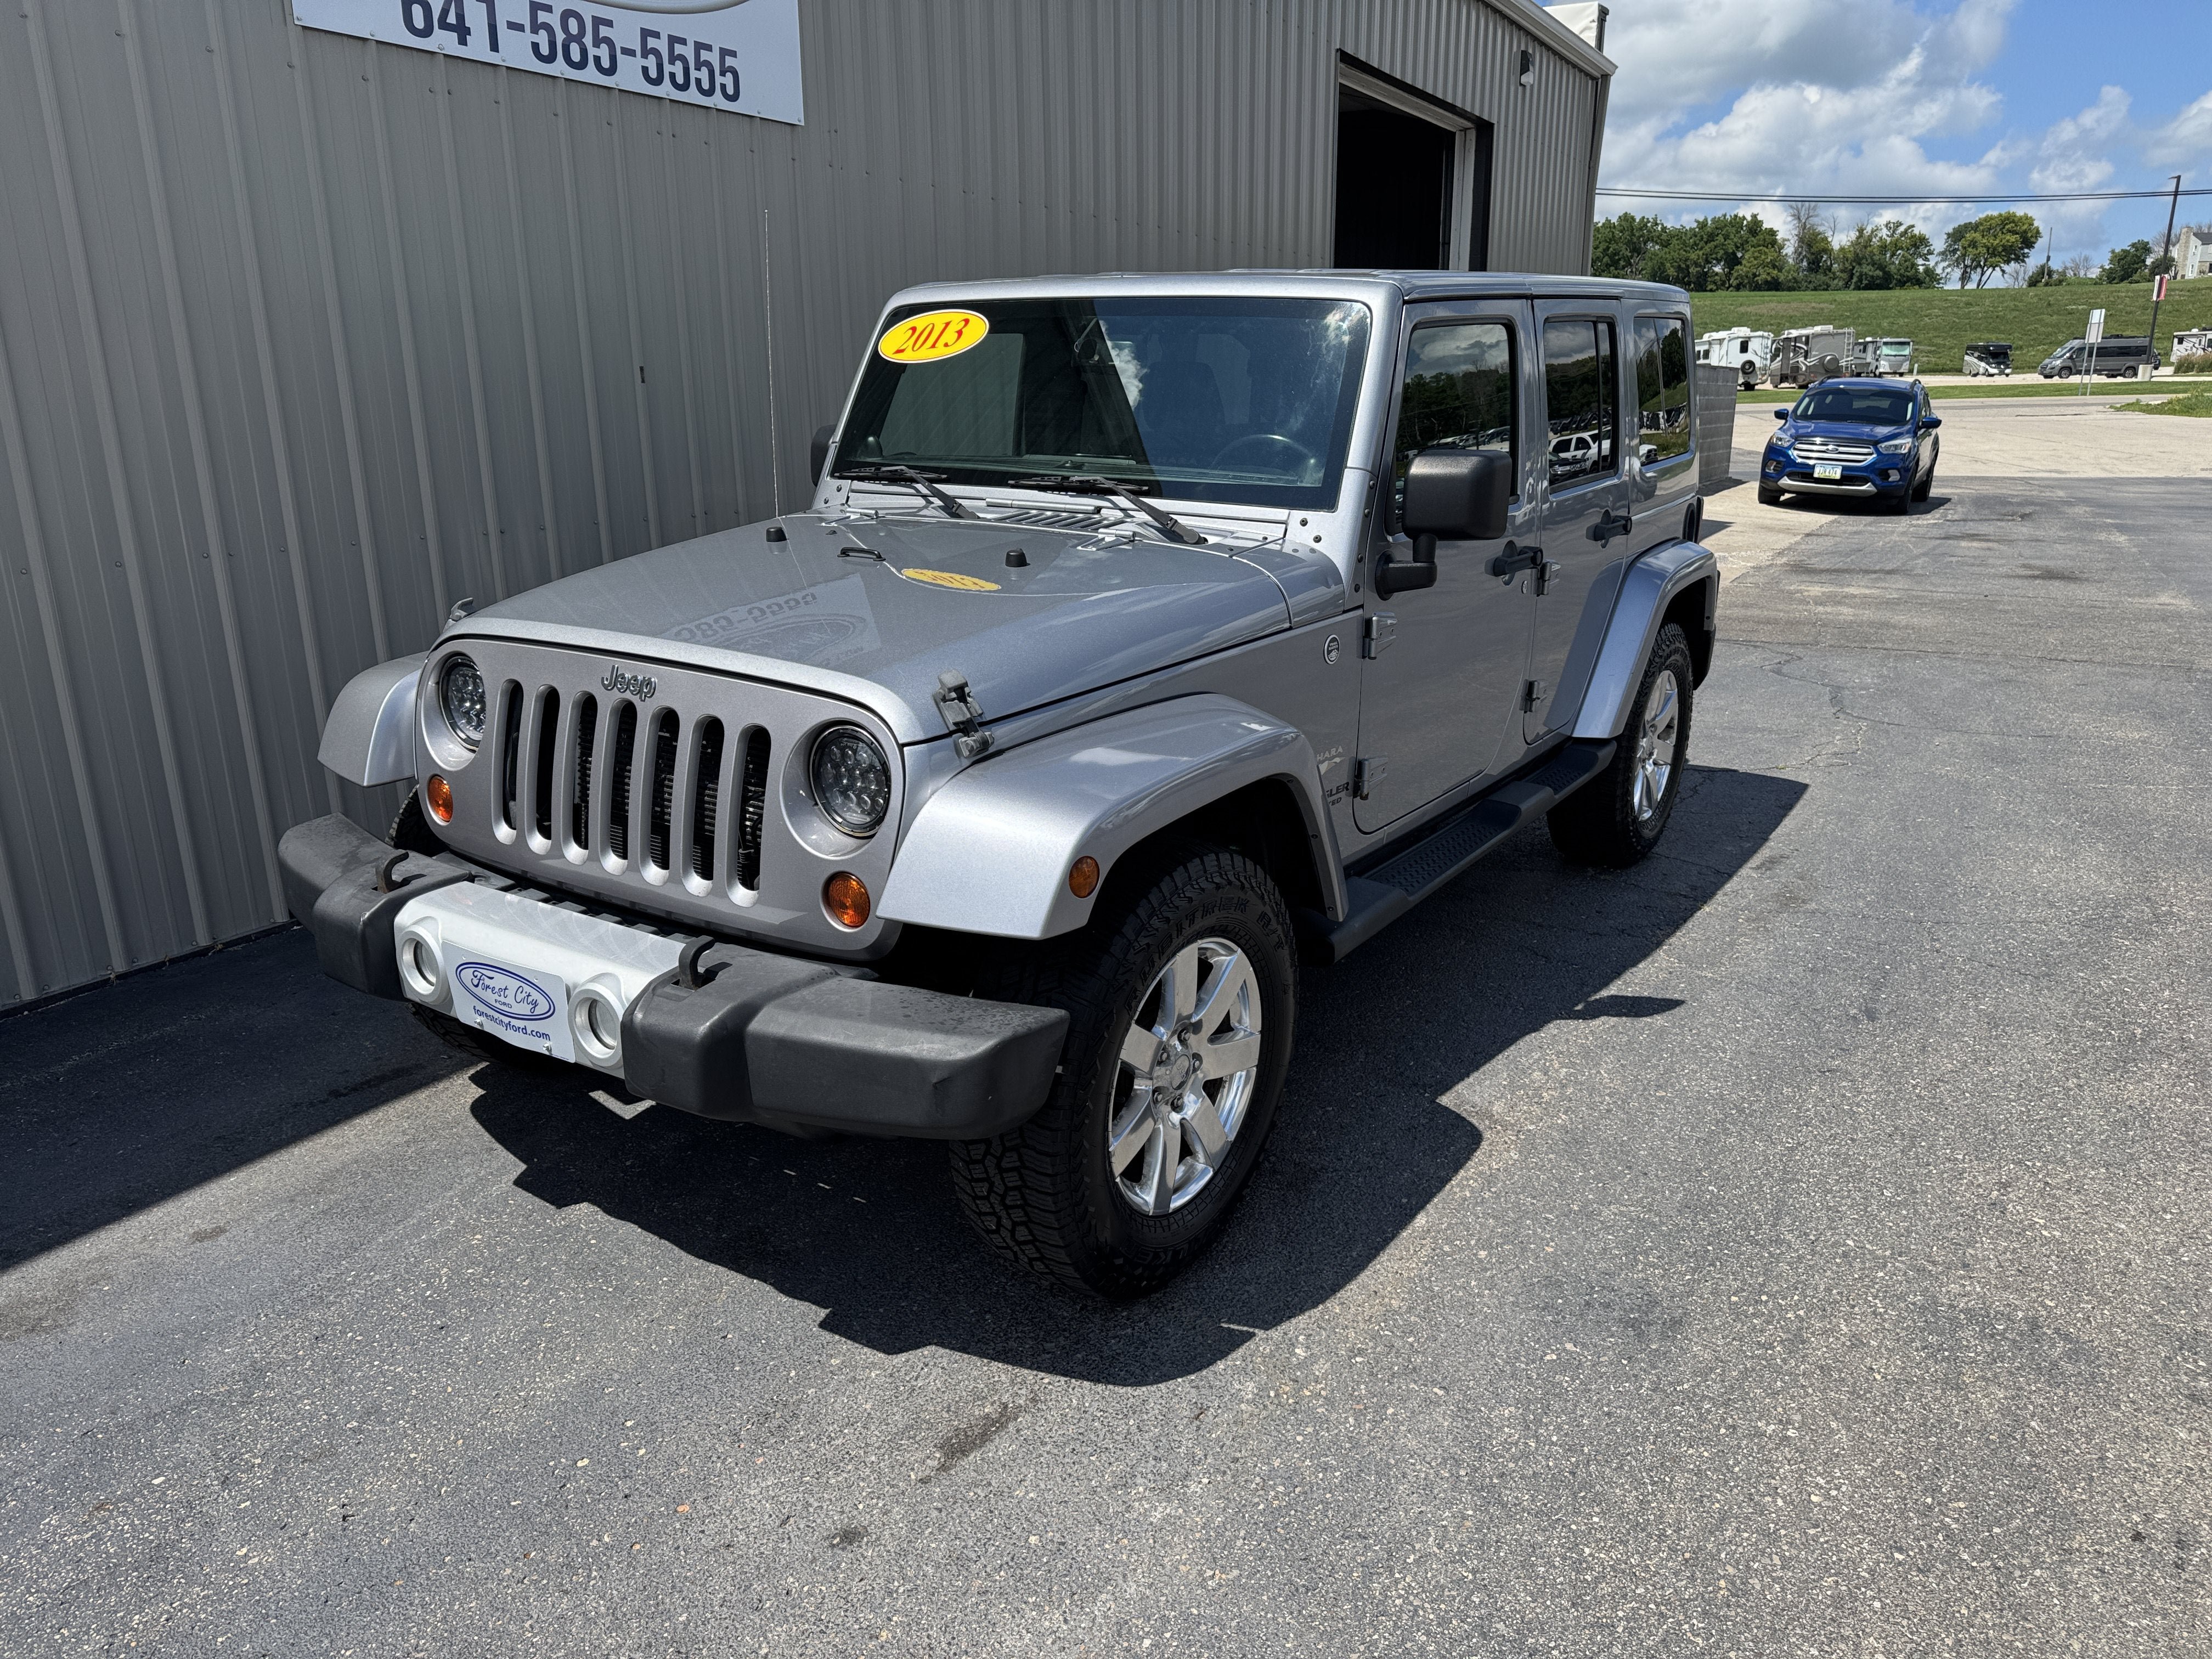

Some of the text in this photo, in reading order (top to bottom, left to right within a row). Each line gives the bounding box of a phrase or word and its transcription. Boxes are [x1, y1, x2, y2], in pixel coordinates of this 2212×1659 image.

[892, 318, 970, 355] 2013
[601, 665, 656, 702] Jeep
[1317, 746, 1343, 761] HARA
[471, 969, 539, 1014] Forest City
[494, 998, 512, 1009] FORD
[473, 1006, 551, 1041] forestcityford.com
